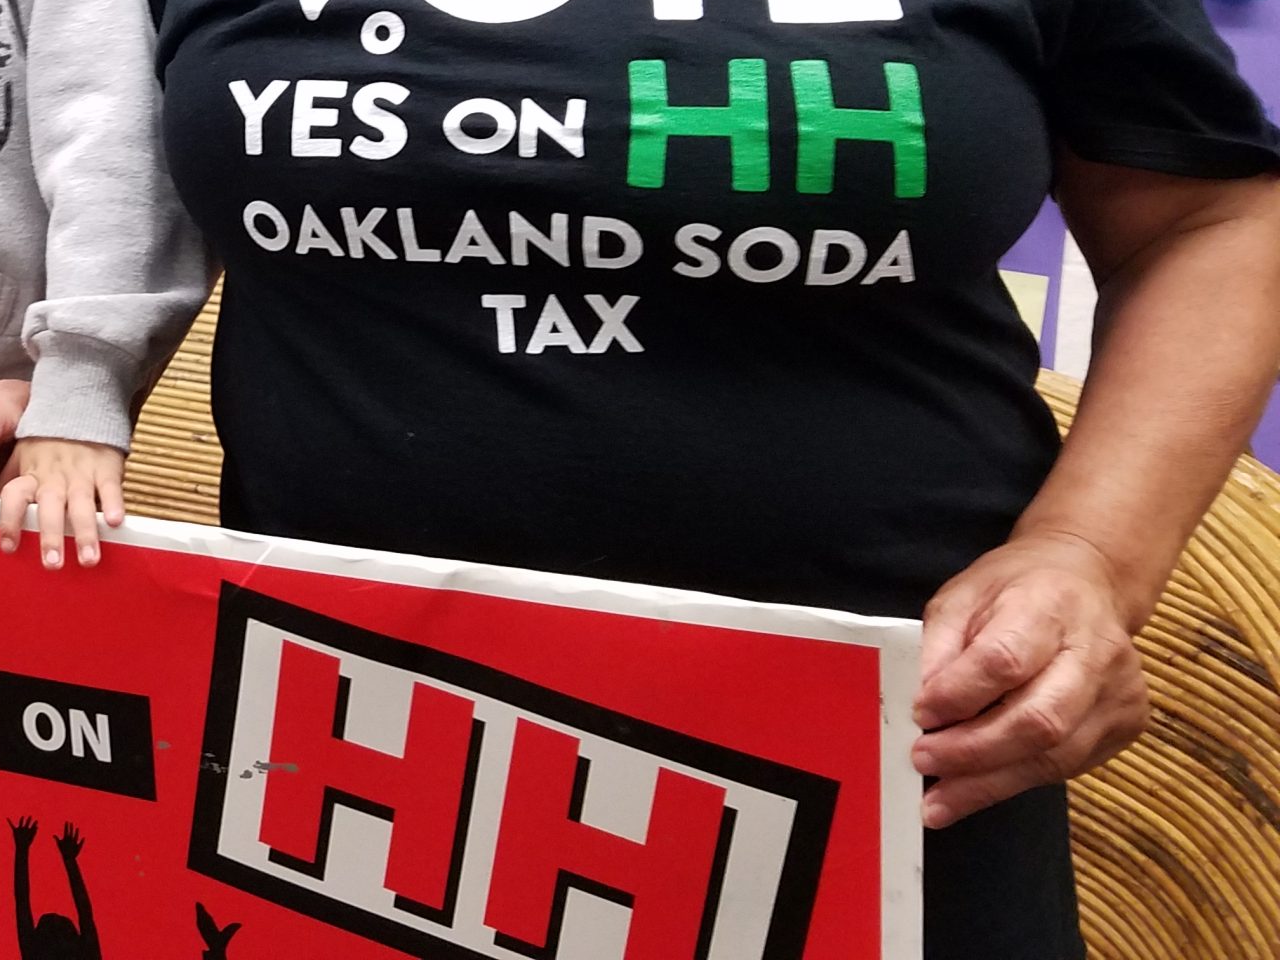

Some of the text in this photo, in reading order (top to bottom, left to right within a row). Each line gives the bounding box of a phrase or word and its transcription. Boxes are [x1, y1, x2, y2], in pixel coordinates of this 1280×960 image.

[229, 58, 928, 199] YES ON HH
[243, 200, 916, 287] OAKLAND SODA
[481, 294, 645, 355] TAX
[22, 701, 113, 763] ON
[258, 638, 738, 960] HH
